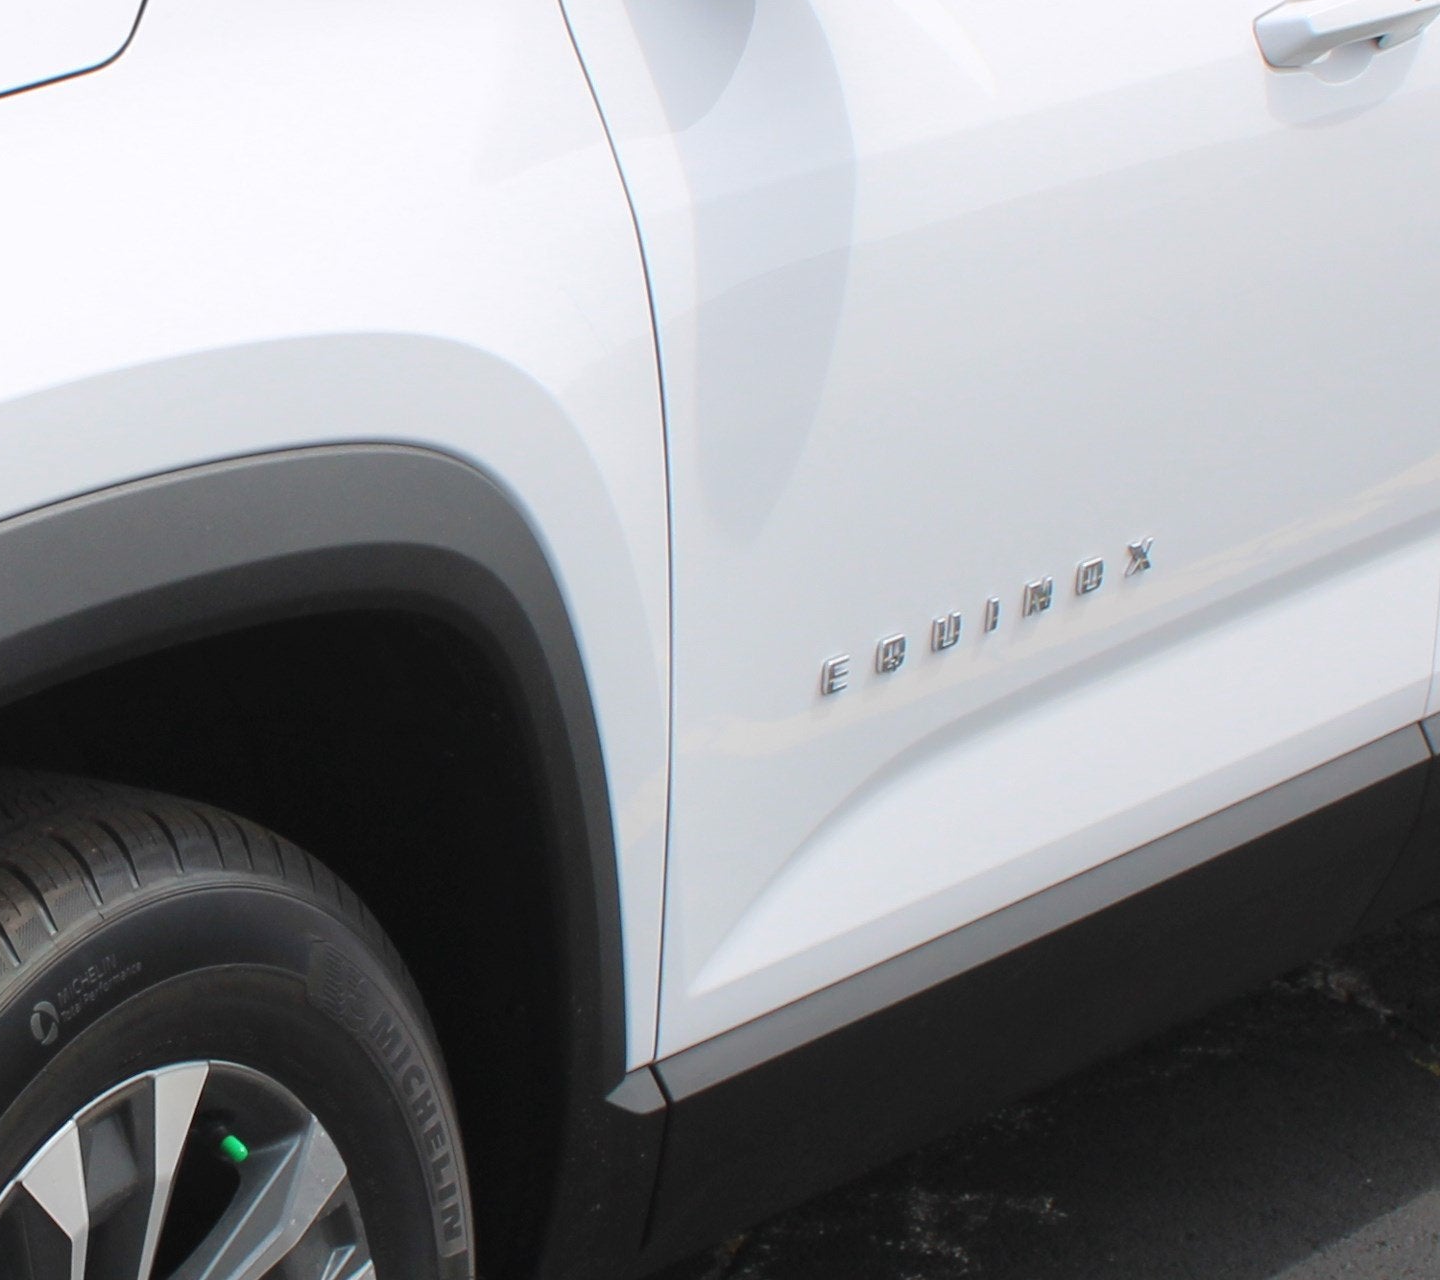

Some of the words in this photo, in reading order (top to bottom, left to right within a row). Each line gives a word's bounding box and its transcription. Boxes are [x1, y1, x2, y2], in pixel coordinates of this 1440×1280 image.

[821, 537, 1154, 695] EQUINOX
[56, 953, 118, 1008] MICHELIN
[371, 1010, 464, 1243] MICHELIN
